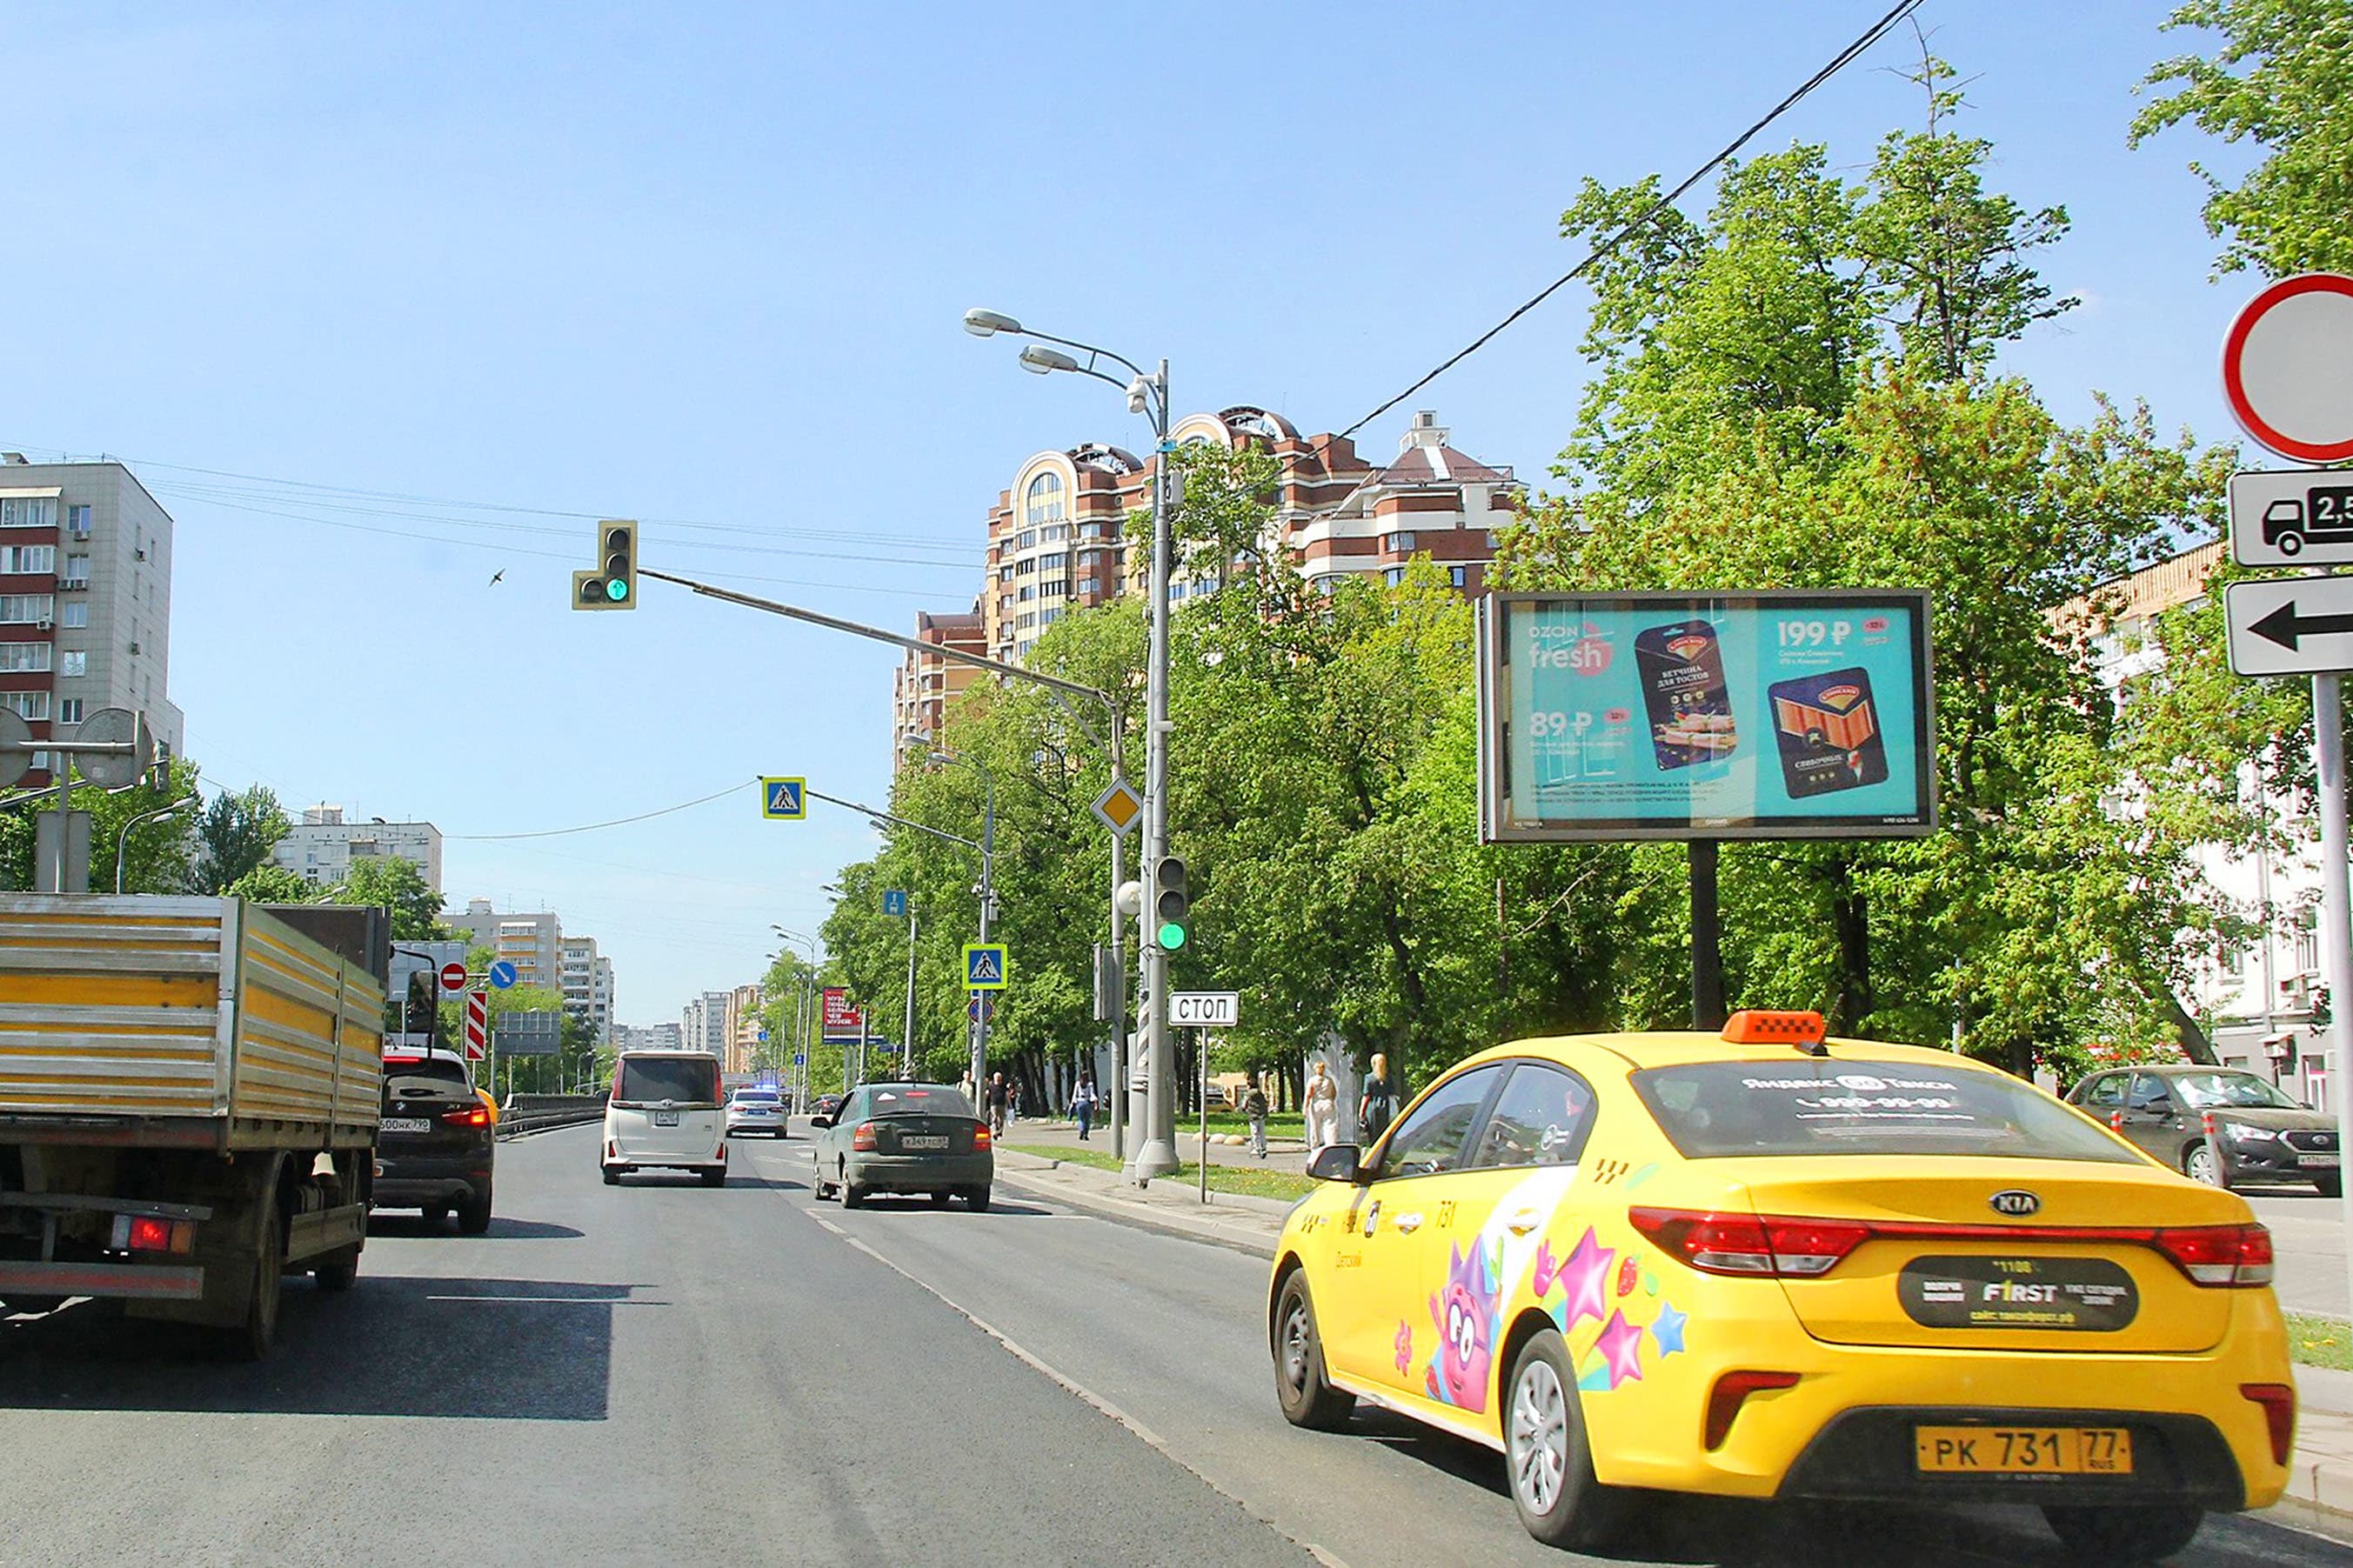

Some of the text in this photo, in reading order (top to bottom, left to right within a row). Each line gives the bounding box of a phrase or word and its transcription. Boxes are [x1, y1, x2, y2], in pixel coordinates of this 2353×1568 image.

[1528, 626, 1579, 638] OZON
[1778, 621, 1826, 646] 199
[1529, 642, 1601, 668] fresh
[1656, 671, 1709, 688] ДЛЯ ТОСТОВ
[1661, 664, 1703, 679] ВЕТЧИНА
[1530, 711, 1566, 737] 89
[1179, 998, 1227, 1019] СТОП
[1741, 1078, 1957, 1090] Яндекс Такси
[1819, 1098, 1951, 1109] 999-99-99
[2000, 1196, 2035, 1211] KIA
[1982, 1279, 2058, 1303] F1RST
[1935, 1431, 2116, 1467] РК 731 77
[2089, 1460, 2116, 1470] RUS
